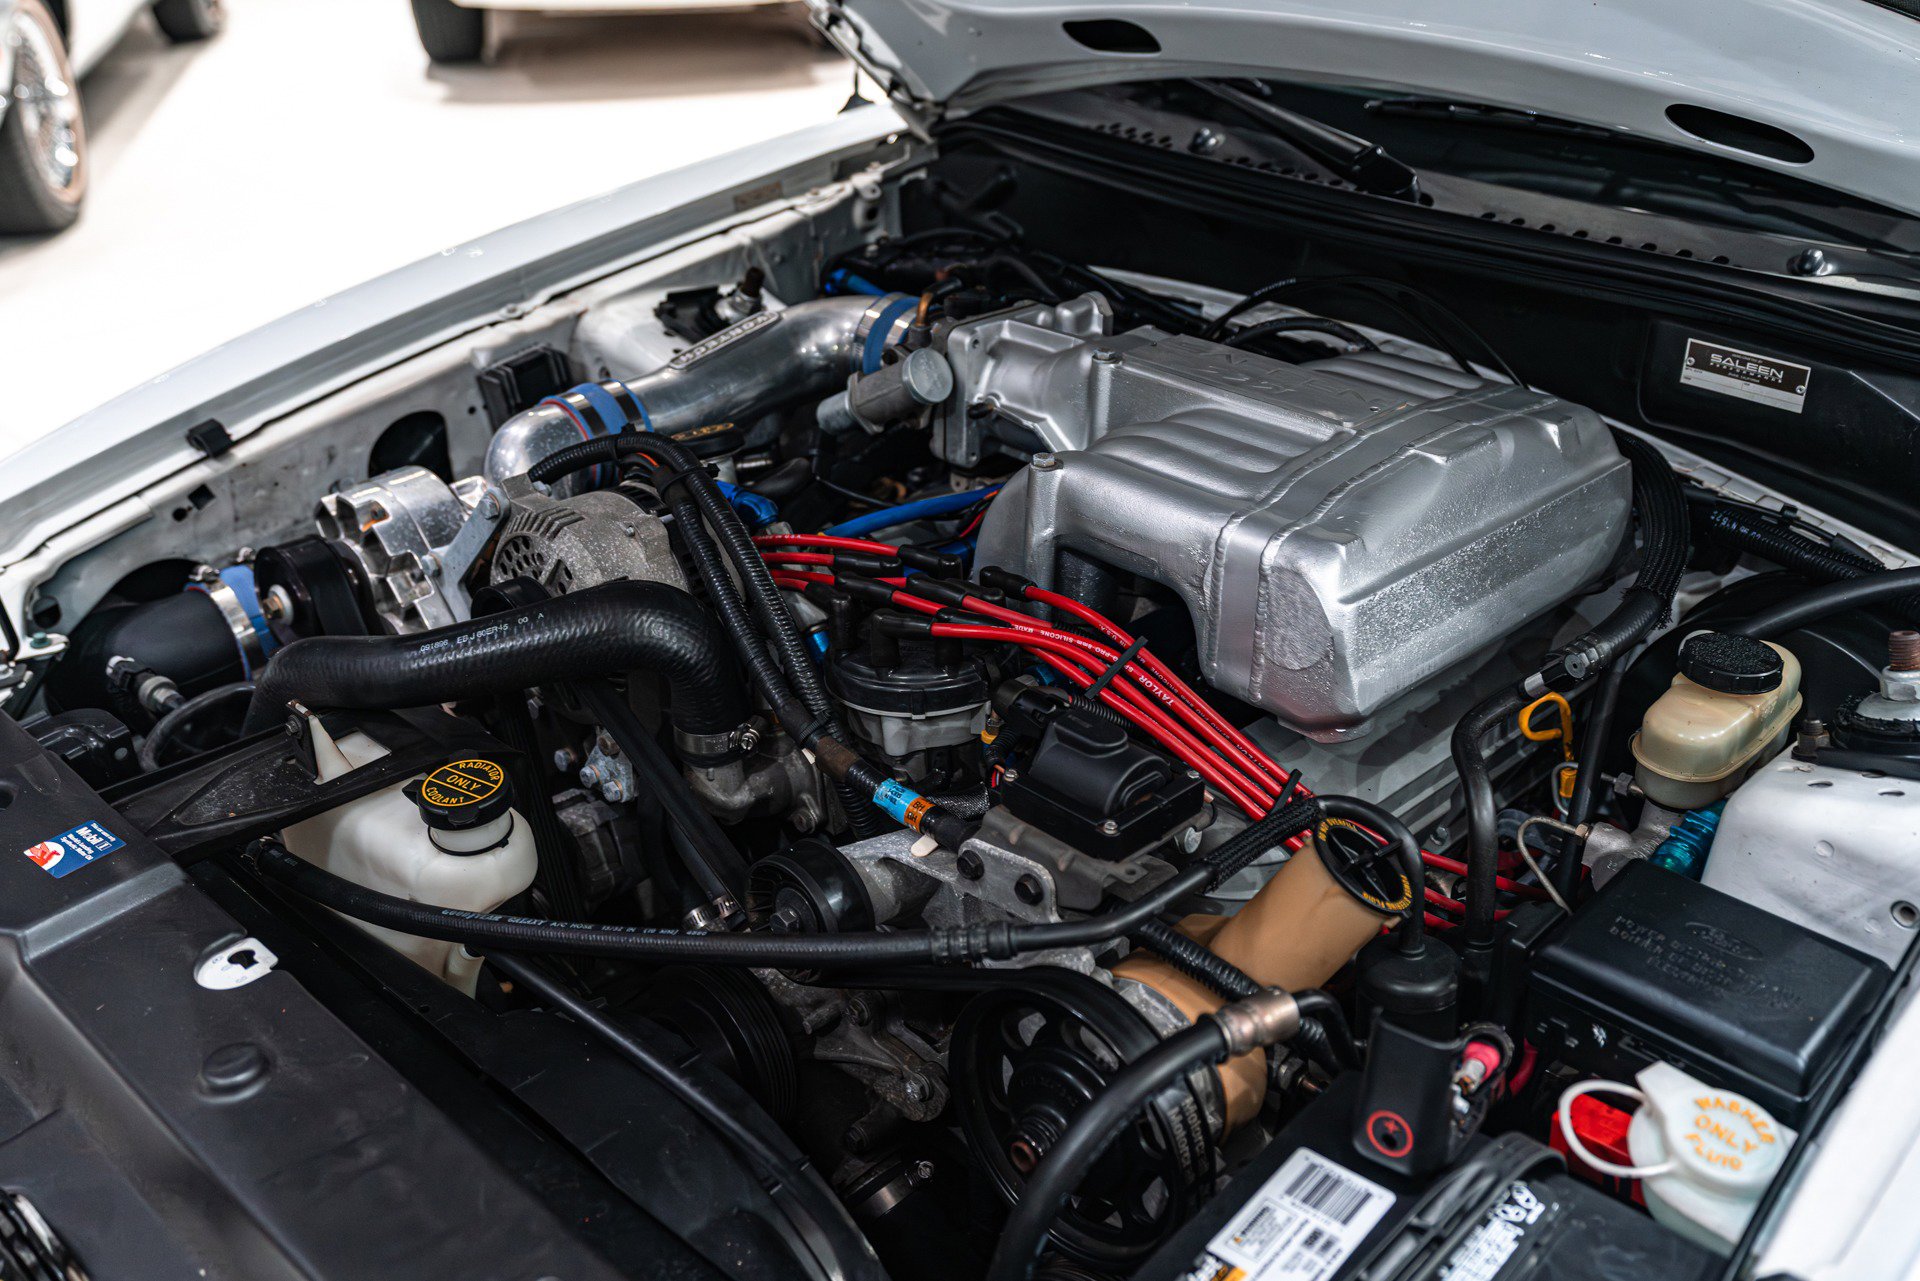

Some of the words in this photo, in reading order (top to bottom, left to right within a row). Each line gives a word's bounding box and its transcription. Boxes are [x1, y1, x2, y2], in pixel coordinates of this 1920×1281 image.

[1710, 353, 1783, 377] SALEEN
[1040, 629, 1074, 643] SILICONE
[1151, 666, 1179, 693] SILICONE
[1138, 674, 1175, 707] TAYLOR
[459, 761, 501, 781] RADIATOR
[446, 773, 482, 791] ONLY
[426, 786, 465, 804] COOLANT
[912, 801, 926, 811] BH
[75, 826, 104, 845] Mobil
[75, 847, 88, 857] Motor
[441, 909, 503, 922] GOODYEAR
[507, 917, 548, 927] GALAXY
[1694, 1096, 1776, 1145] WASHER
[1694, 1113, 1759, 1155] ONLY
[1684, 1132, 1744, 1172] FLUID
